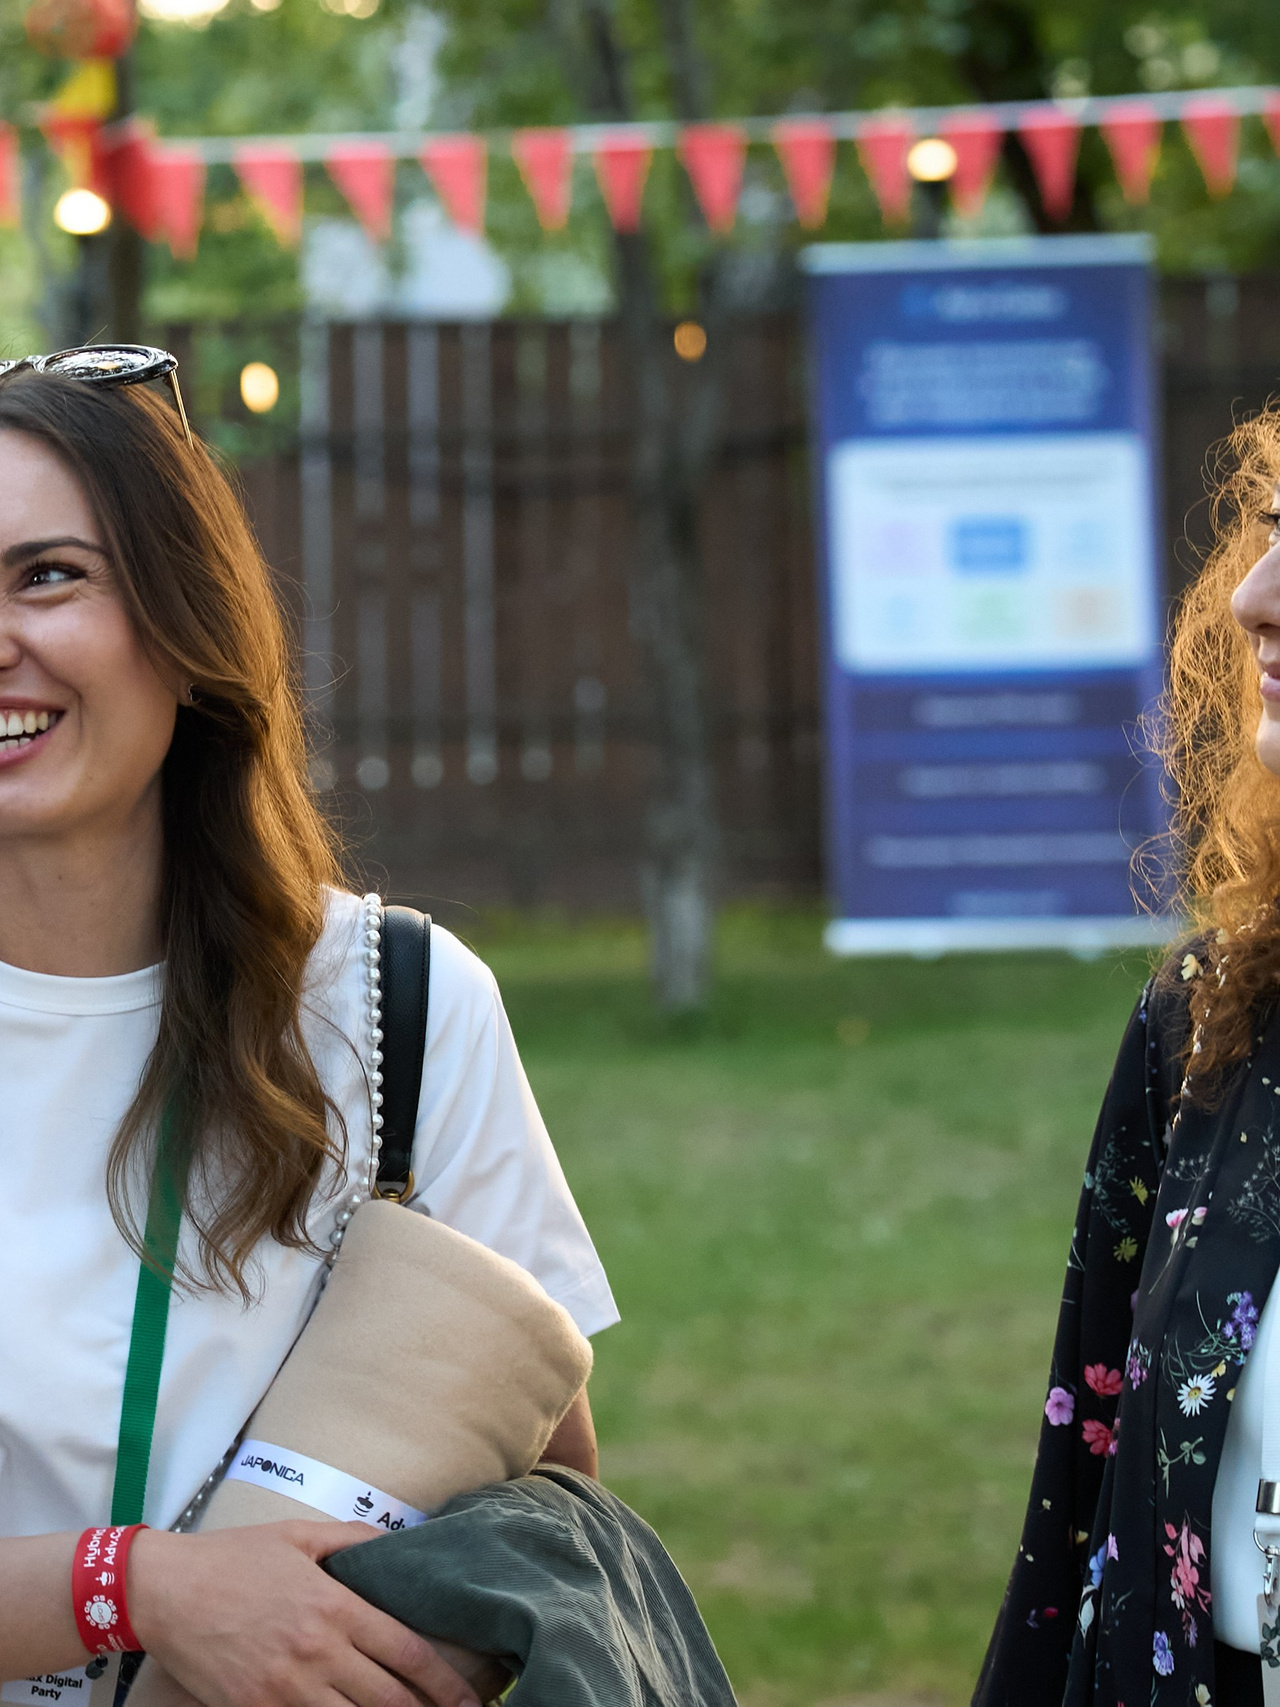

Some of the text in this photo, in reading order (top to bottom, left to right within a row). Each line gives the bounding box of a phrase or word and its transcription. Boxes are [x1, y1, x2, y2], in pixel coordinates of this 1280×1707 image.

[241, 1455, 304, 1486] JAPONICA
[377, 1511, 406, 1532] Ad
[45, 1674, 83, 1688] Digital
[31, 1685, 61, 1701] Party
